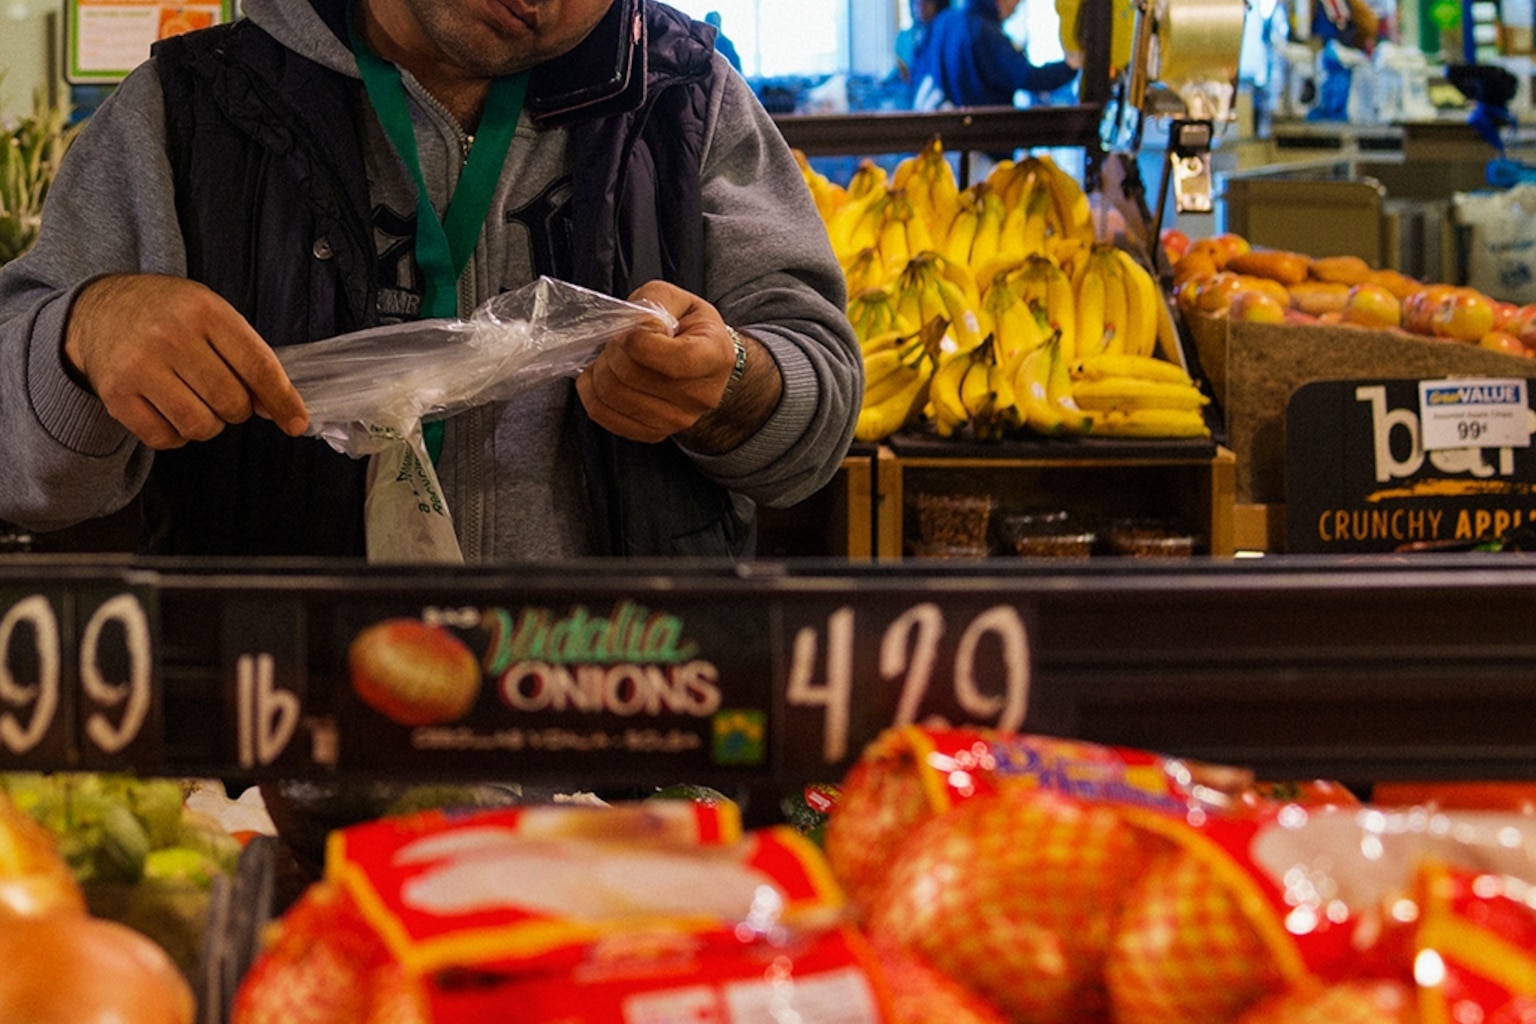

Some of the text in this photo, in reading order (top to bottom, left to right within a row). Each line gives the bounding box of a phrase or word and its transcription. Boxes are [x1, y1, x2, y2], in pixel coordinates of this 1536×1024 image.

[1318, 507, 1444, 542] CRUNCHY
[480, 599, 699, 675] Vidalia
[500, 660, 722, 717] ONIONS
